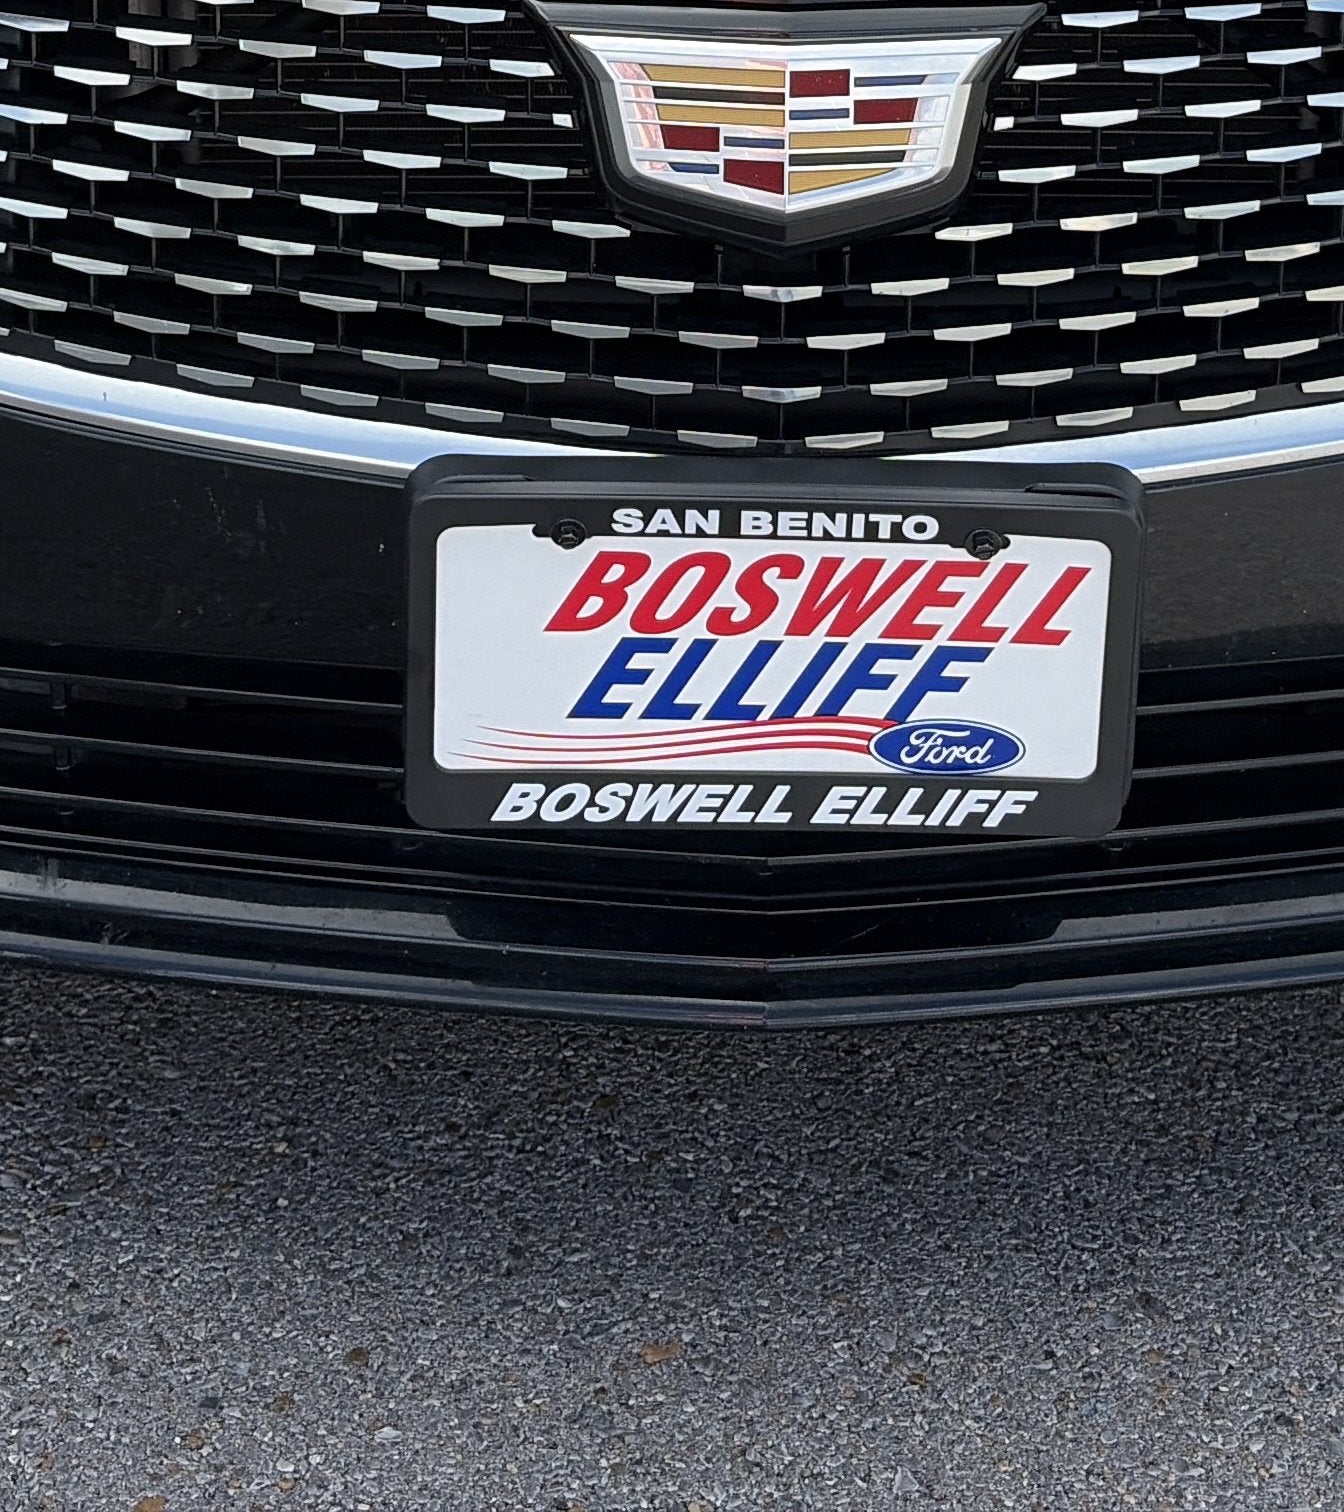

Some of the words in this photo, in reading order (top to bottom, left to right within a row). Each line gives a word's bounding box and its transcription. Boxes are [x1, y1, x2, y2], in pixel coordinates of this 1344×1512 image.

[611, 508, 720, 536] SAN
[740, 511, 940, 540] BENITO
[543, 551, 1093, 646] BOSWELL
[566, 638, 993, 722] ELLIFF
[899, 728, 995, 765] Ford
[490, 783, 792, 824] BOSWELL
[809, 786, 1039, 827] ELLIFF
